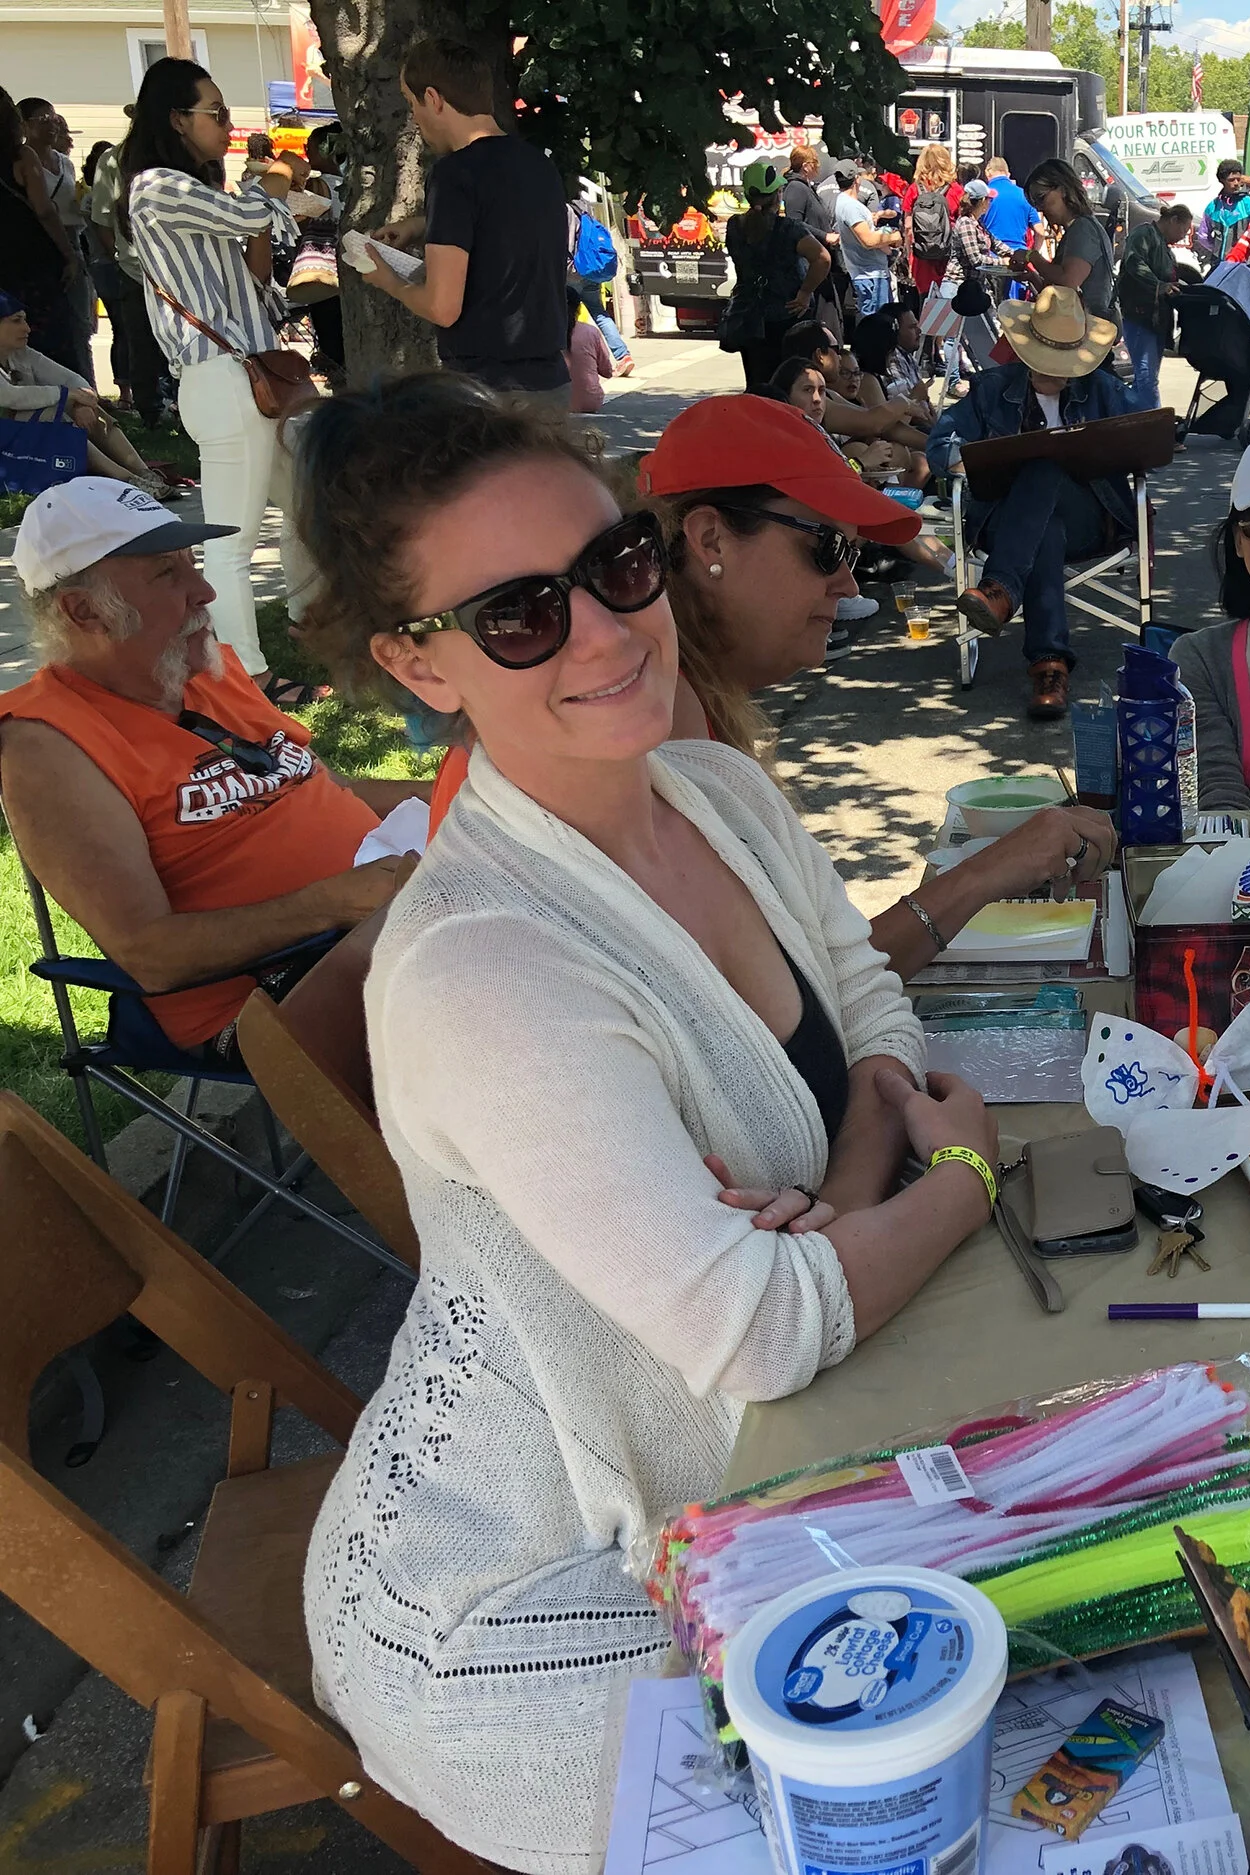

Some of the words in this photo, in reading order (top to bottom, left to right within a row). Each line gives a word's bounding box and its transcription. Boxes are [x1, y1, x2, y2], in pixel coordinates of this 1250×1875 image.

[1107, 124, 1144, 139] YOUR
[1149, 122, 1196, 138] ROUTE
[1199, 121, 1217, 135] TO
[1110, 144, 1119, 156] A
[1124, 142, 1156, 156] NEW
[1161, 140, 1215, 154] CAREER
[189, 759, 236, 782] WES
[835, 1627, 867, 1666] Lowfat
[845, 1629, 880, 1677] Cottage
[861, 1631, 896, 1676] Cheese
[1162, 1769, 1173, 1785] San
